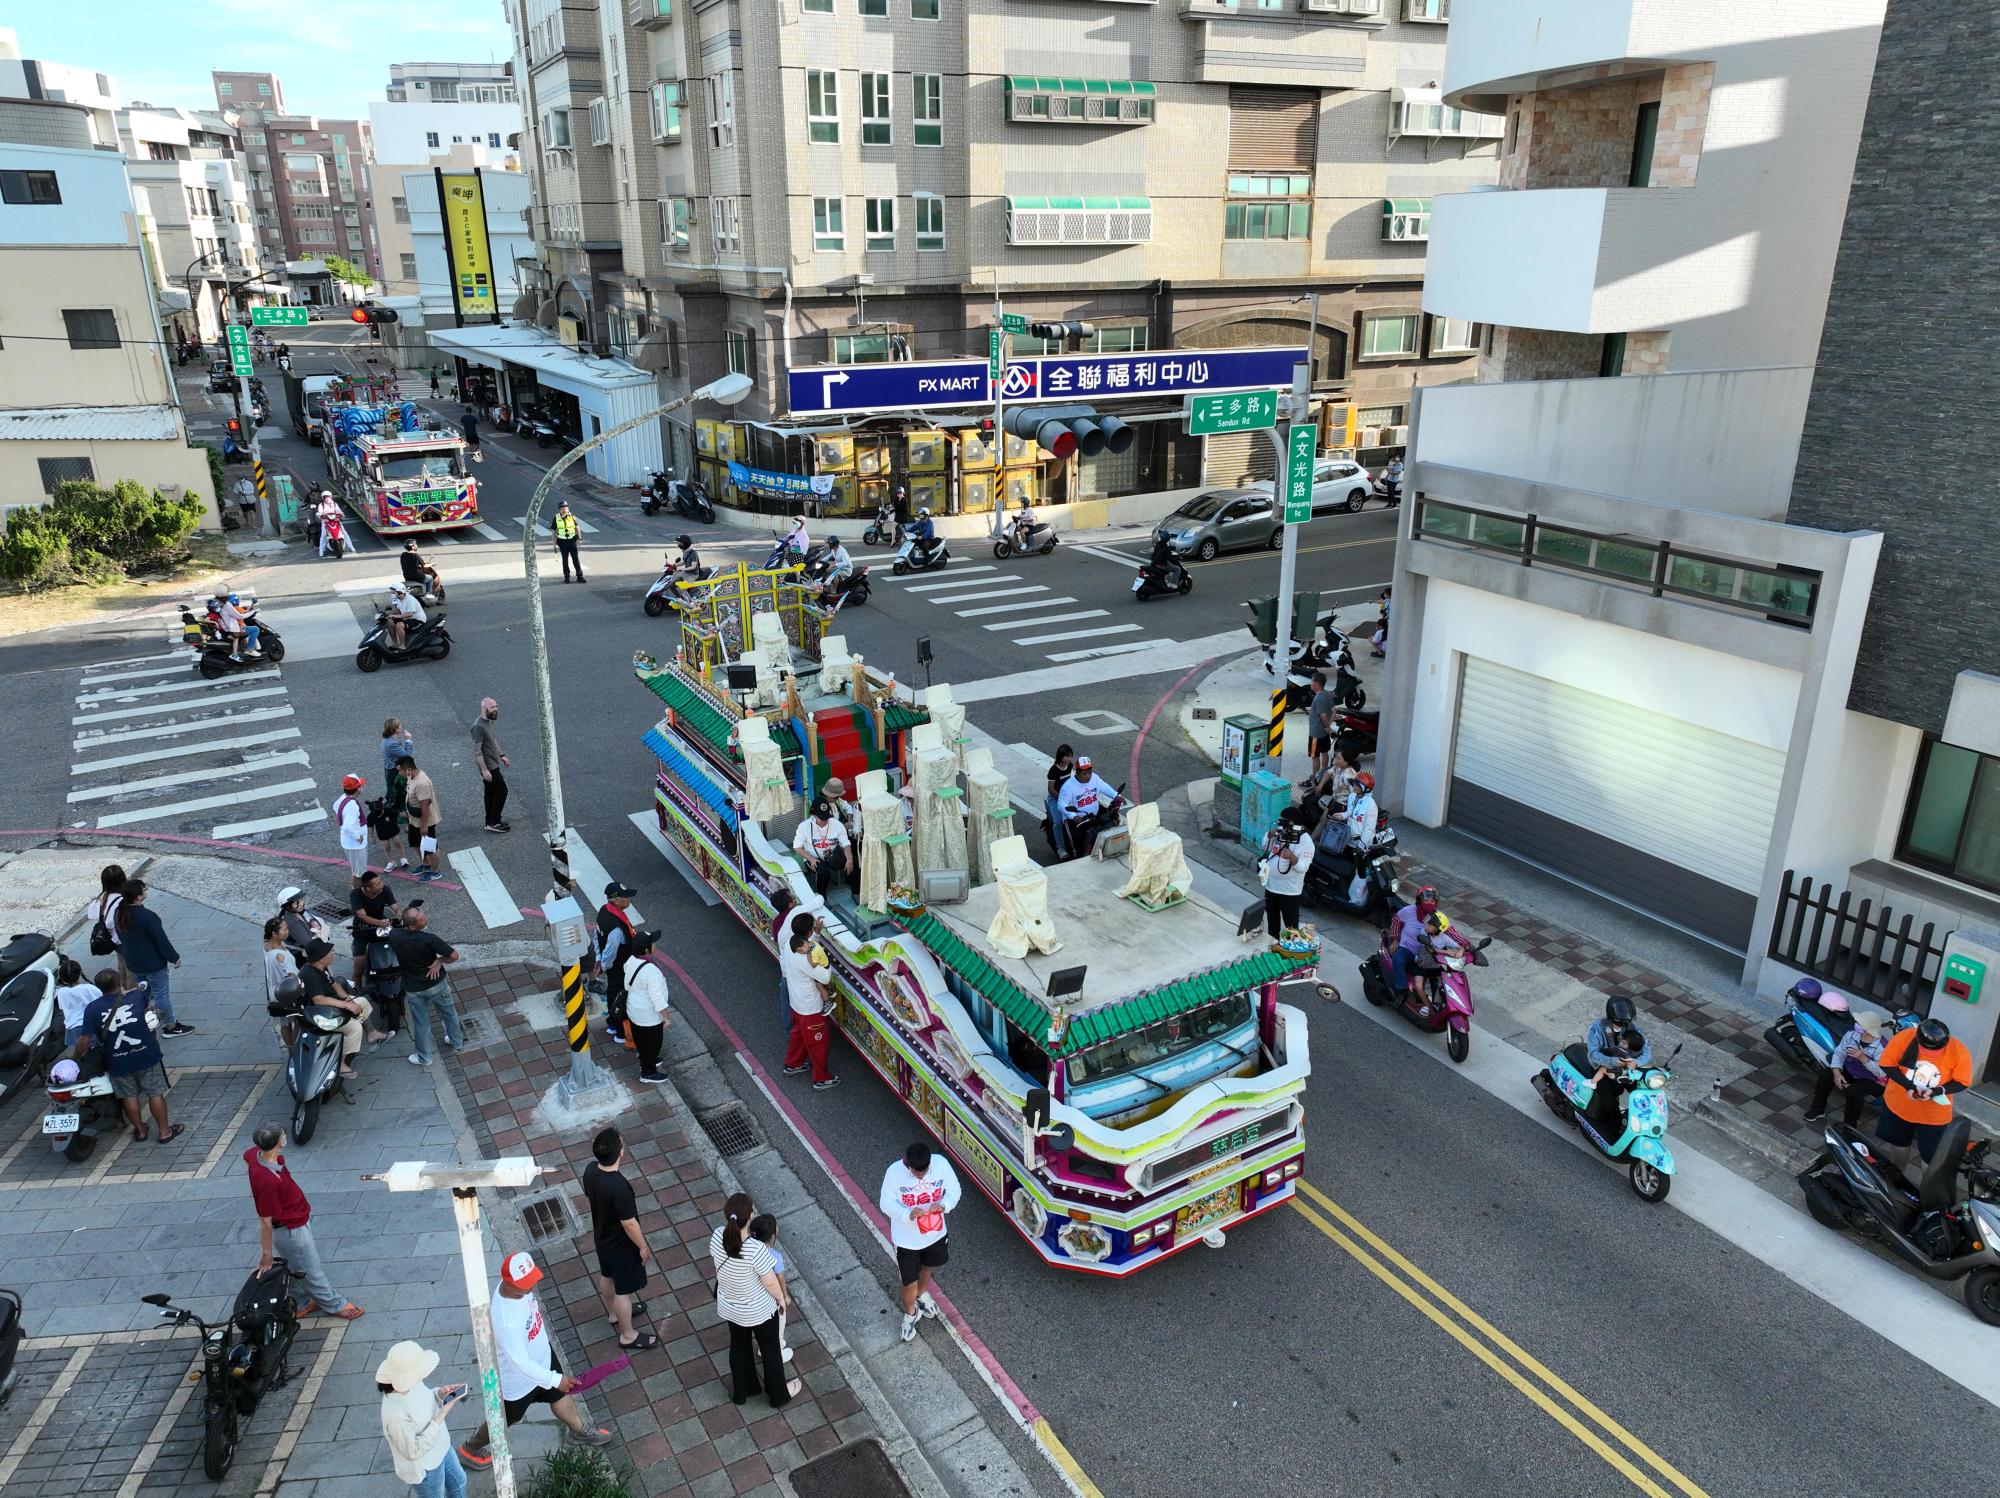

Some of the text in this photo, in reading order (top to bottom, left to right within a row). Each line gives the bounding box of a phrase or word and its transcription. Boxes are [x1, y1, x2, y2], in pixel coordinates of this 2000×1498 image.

[263, 309, 296, 318] 三多路
[918, 376, 980, 393] PX MART
[1048, 360, 1209, 391] 全聯福利中心
[1209, 396, 1260, 417] 三多路
[1217, 417, 1250, 427] Sanduo Rd
[1292, 442, 1308, 498] 文光路
